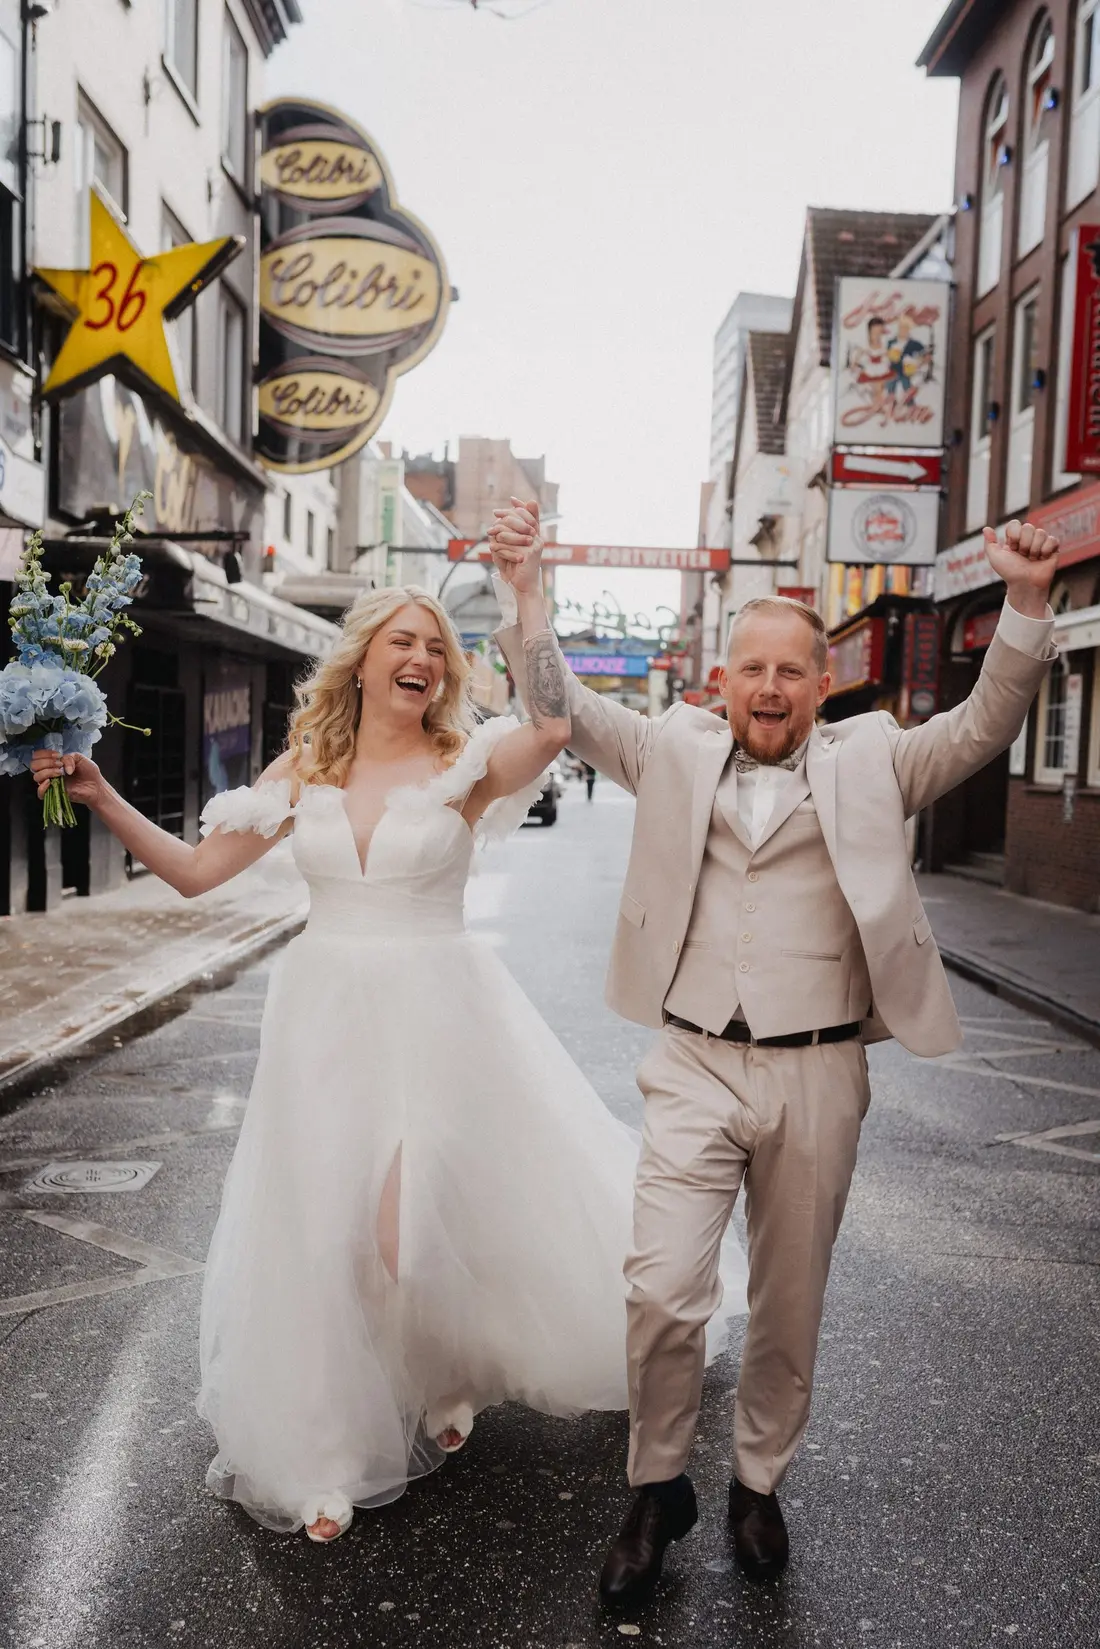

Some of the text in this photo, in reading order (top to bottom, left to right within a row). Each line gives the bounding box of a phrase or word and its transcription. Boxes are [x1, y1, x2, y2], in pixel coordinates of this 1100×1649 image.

[275, 149, 372, 186] Colibri
[84, 260, 147, 332] 36
[268, 251, 430, 312] Colibri
[270, 380, 369, 416] Colibri
[586, 547, 711, 569] SPORTWETTEN
